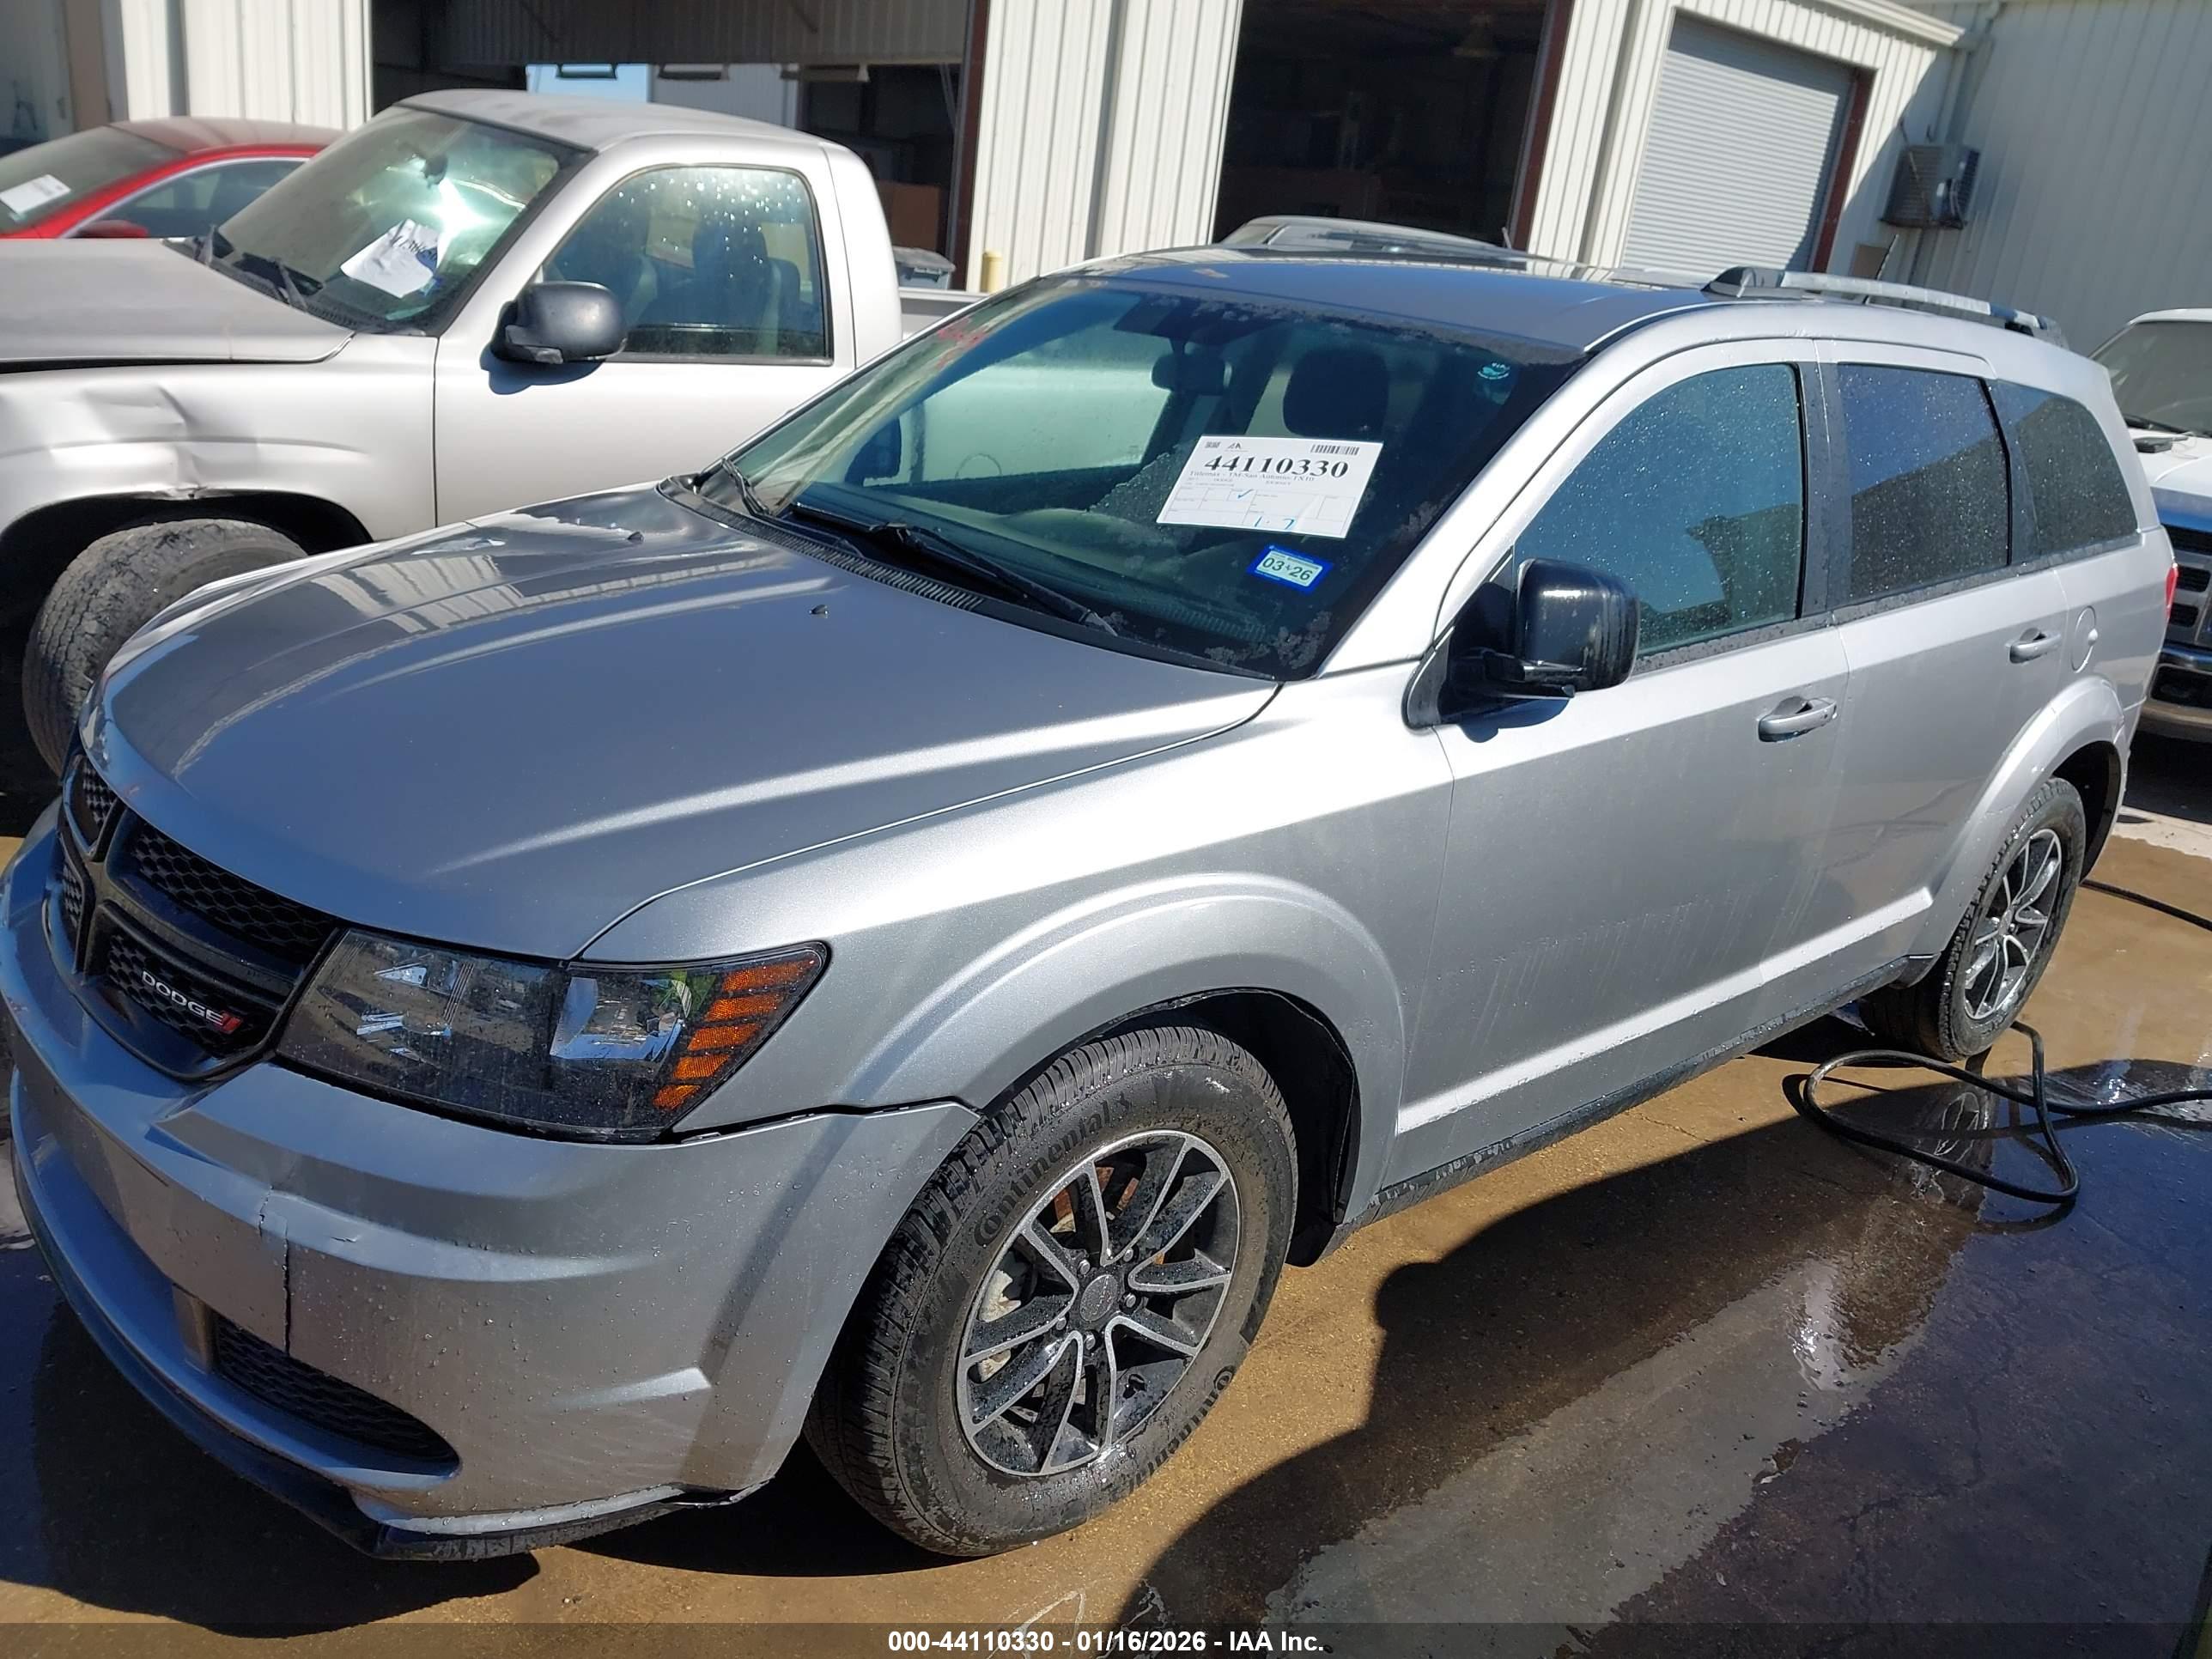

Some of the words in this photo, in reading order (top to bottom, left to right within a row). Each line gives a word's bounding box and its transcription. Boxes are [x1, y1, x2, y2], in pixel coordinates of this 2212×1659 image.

[1204, 455, 1348, 478] 44110330
[1262, 557, 1285, 571] 03
[1289, 566, 1313, 580] 26
[143, 970, 223, 1025] DODGE
[974, 1100, 1110, 1245] Continental
